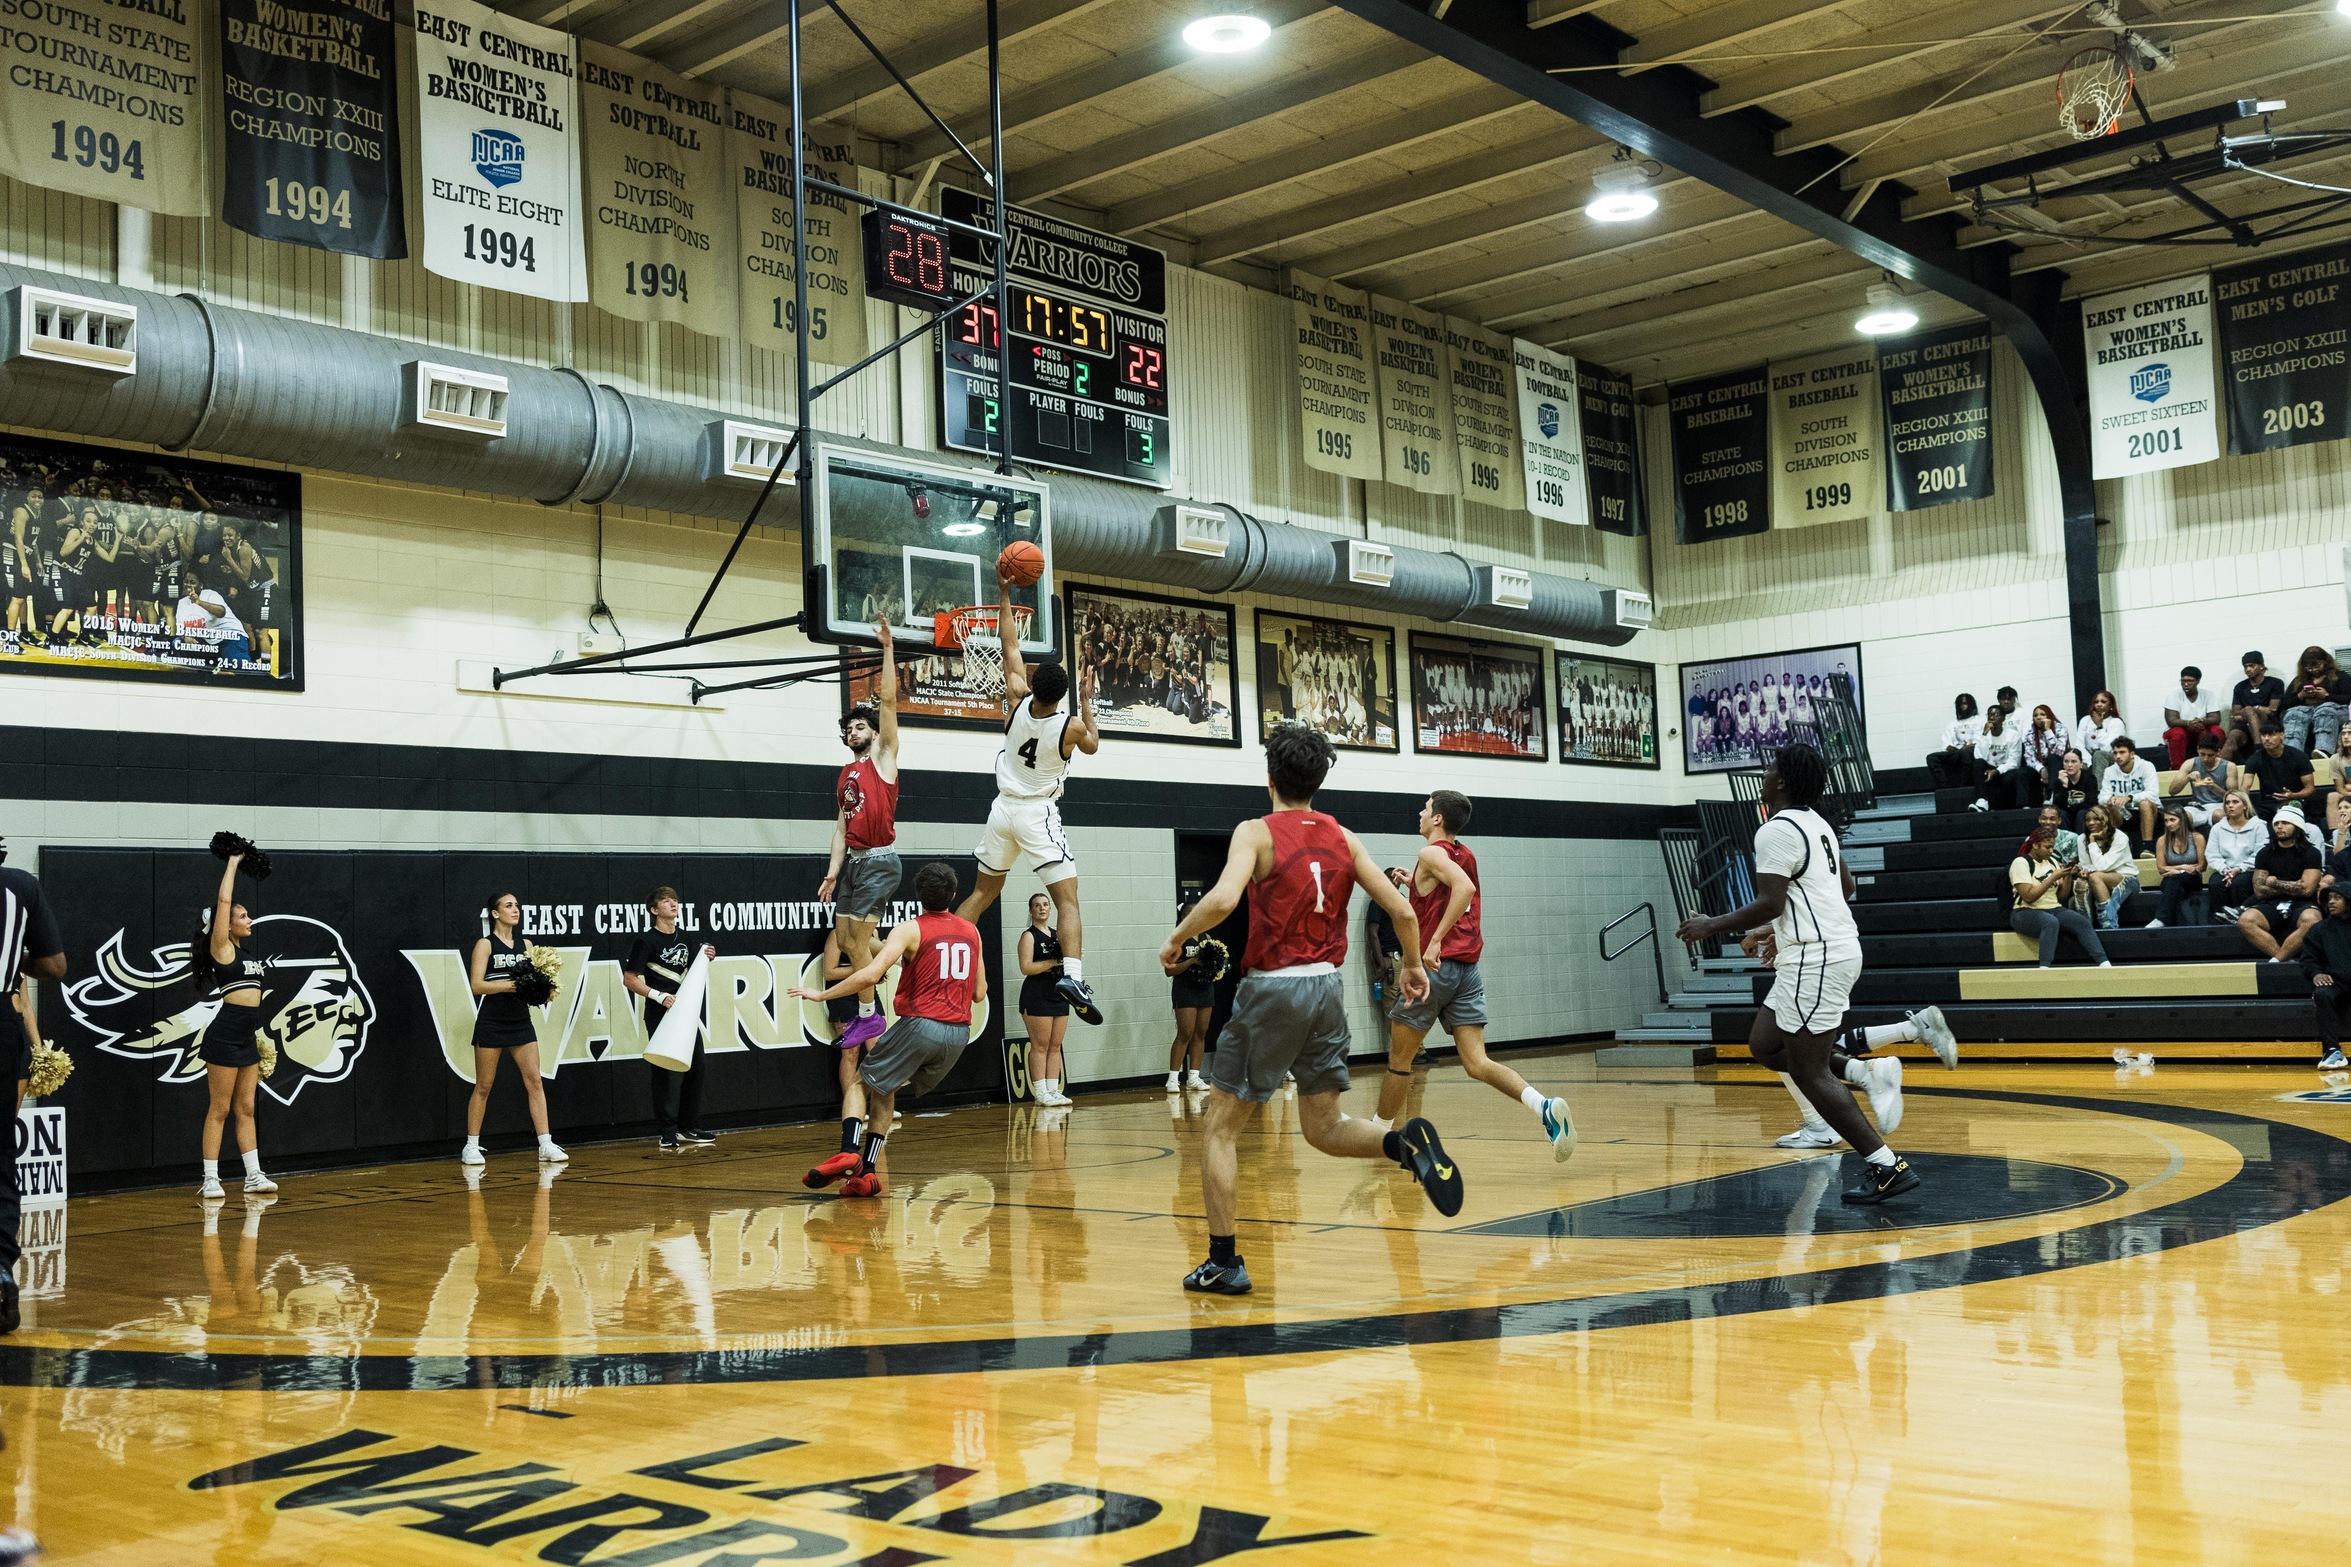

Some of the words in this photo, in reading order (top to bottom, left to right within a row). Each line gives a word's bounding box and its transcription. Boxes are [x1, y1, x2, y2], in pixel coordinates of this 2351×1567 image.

[2, 0, 101, 38] SOUTH
[108, 23, 191, 63] STATE
[255, 0, 363, 48] WOMEN'S
[227, 17, 381, 80] BASKETBALL
[417, 10, 471, 48] EAST
[479, 30, 573, 78] CENTRAL
[0, 26, 197, 95] TOURNAMENT
[10, 64, 184, 126] CHAMPIONS
[447, 56, 546, 102] WOMEN'S
[585, 62, 634, 96] EAST
[643, 80, 722, 126] CENTRAL
[225, 74, 326, 117] REGION
[333, 98, 384, 133] XXIII
[428, 74, 563, 132] BASKETBALL
[230, 109, 381, 161] CHAMPIONS
[610, 103, 700, 152] SOFTBALL
[734, 110, 778, 142] EAST
[51, 119, 145, 181] 1994
[471, 132, 525, 163] NJCAA
[624, 155, 685, 190] NORTH
[266, 177, 352, 229] 1994
[432, 178, 491, 213] ELITE
[497, 194, 563, 227] EIGHT
[614, 181, 694, 221] DIVISION
[599, 206, 710, 252] CHAMPIONS
[771, 207, 831, 237] SOTH
[891, 213, 937, 231] DAKTRONICS
[1008, 211, 1045, 231] CENTRAL
[1045, 221, 1093, 246] COMMUNITY
[1094, 236, 1128, 257] COLLEGE
[463, 224, 535, 273] 1994
[761, 231, 839, 267] DIVIION
[888, 224, 944, 292] 28
[971, 213, 1141, 302] WARRIORS
[625, 261, 689, 304] 1994
[747, 255, 848, 296] CHAMIONS
[2217, 277, 2260, 300] EAST
[2268, 258, 2349, 288] CENTRAL
[772, 296, 827, 340] 195
[2086, 307, 2126, 329] EAST
[2133, 289, 2209, 318] CENTRAL
[2231, 295, 2285, 321] MEN'S
[2292, 284, 2340, 308] GOLF
[962, 304, 999, 348] 37
[1025, 293, 1107, 351] 17:57
[1115, 314, 1165, 345] VISITOR
[1374, 310, 1397, 330] EAST
[2110, 317, 2186, 347] WOMEN'S
[1042, 347, 1061, 361] POSS
[1515, 352, 1535, 371] EAST
[1882, 350, 1918, 370] EAST
[1923, 335, 1990, 362] CENTRAL
[2097, 331, 2203, 366] BASKETBALL
[2230, 339, 2300, 364] REGION
[2304, 329, 2348, 350] XXIII
[1034, 358, 1070, 379] PERIOD
[1075, 362, 1089, 394] 2
[1128, 344, 1161, 388] 22
[1298, 354, 1333, 376] SOUTH
[1772, 371, 1806, 391] EAST
[1811, 359, 1874, 383] CENTRAL
[1903, 361, 1971, 387] WOMEN'S
[2129, 365, 2172, 395] NJCAA
[2236, 350, 2346, 382] CHAMPIONS
[967, 378, 999, 398] FOULS
[1115, 387, 1146, 407] BONUS
[1526, 377, 1569, 402] FOOTBALL
[1672, 393, 1703, 411] EAST
[1708, 379, 1767, 404] CENTRAL
[1788, 384, 1859, 409] BASEBALL
[1892, 374, 1986, 405] BASKETBALL
[985, 400, 999, 432] 2
[1029, 392, 1066, 413] PLAYER
[1075, 402, 1104, 422] FOULS
[1125, 413, 1153, 432] FOULS
[1302, 397, 1366, 424] CHAMPIONS
[1687, 403, 1753, 429] BASEBALL
[1892, 413, 1950, 436] REGION
[1953, 407, 1988, 425] XXIII
[2102, 411, 2148, 431] SWEET
[2150, 399, 2209, 421] SIXTEEN
[2263, 400, 2325, 435] 2003
[1801, 416, 1848, 435] SOUTH
[1896, 426, 1987, 453] CHAMPIONS
[1140, 433, 1153, 464] 3
[1317, 428, 1352, 460] 1995
[1528, 442, 1538, 454] IN
[1539, 444, 1551, 459] THE
[1553, 448, 1580, 465] NATION
[1702, 446, 1742, 464] STATE
[1795, 432, 1857, 454] DIVISION
[2128, 426, 2183, 459] 2001
[1471, 461, 1499, 491] 1996
[1543, 463, 1571, 481] RECORD
[1684, 460, 1764, 485] CHAMPIONS
[1785, 449, 1870, 473] CHAMPIONS
[1536, 480, 1563, 507] 1996
[1917, 463, 1968, 494] 2001
[1601, 495, 1625, 520] 1997
[1805, 482, 1851, 510] 1999
[1704, 500, 1749, 528] 1998
[83, 614, 115, 631] 2016
[175, 620, 241, 642] BASKETBALL
[121, 651, 157, 664] DIVISION
[160, 653, 206, 667] CHAMPIONS
[217, 656, 238, 669] 24-3
[241, 659, 272, 672] RECORD
[174, 639, 219, 654] CHAMPIONS
[916, 687, 937, 696] MACJC
[938, 688, 954, 697] State
[955, 690, 987, 700] Champions
[932, 679, 947, 688] 2011
[909, 696, 930, 705] NJCAA
[930, 697, 967, 708] Tournament
[967, 700, 978, 708] 5th
[978, 701, 995, 710] Place
[943, 708, 962, 716] 37-15
[1018, 737, 1039, 769] 4
[1309, 861, 1325, 913] 1
[521, 904, 584, 935] EAST
[709, 901, 837, 931] COMMUNITY
[935, 942, 971, 980] 10
[626, 1436, 1378, 1567] LADY
